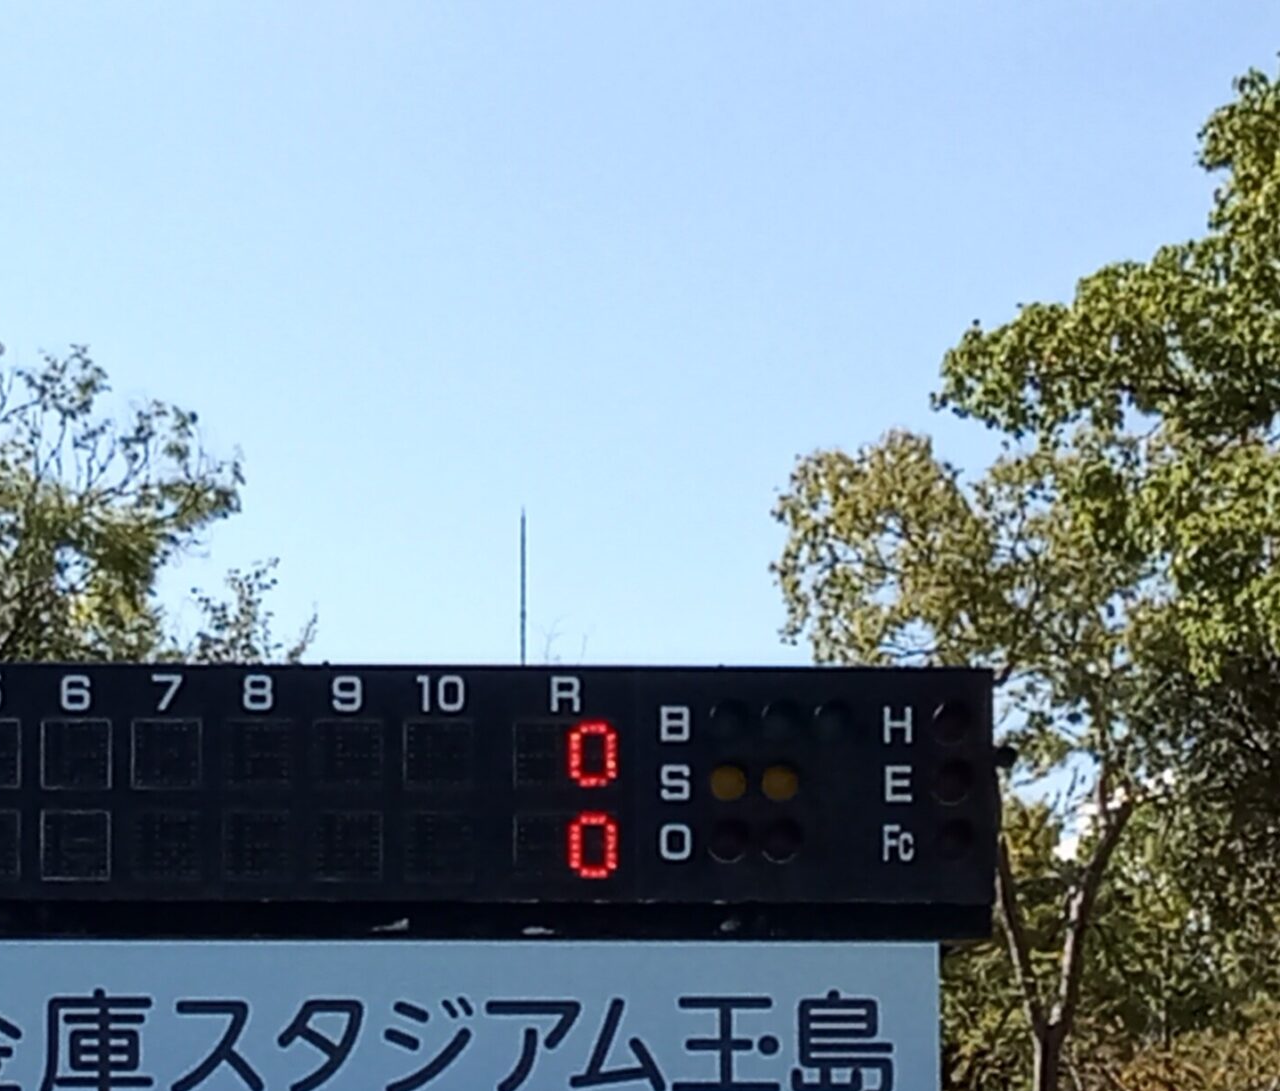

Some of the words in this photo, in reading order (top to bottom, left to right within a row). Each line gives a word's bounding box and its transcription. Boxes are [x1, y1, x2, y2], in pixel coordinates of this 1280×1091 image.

[61, 674, 91, 711] 6
[151, 673, 183, 711] 7
[243, 674, 273, 711] 8
[332, 675, 362, 712] 9
[416, 674, 465, 712] 10
[550, 675, 581, 712] R
[660, 705, 690, 742] B
[883, 706, 912, 744] H
[566, 718, 618, 788] 0
[660, 764, 690, 800] S
[885, 765, 913, 802] E
[566, 811, 619, 879] 0
